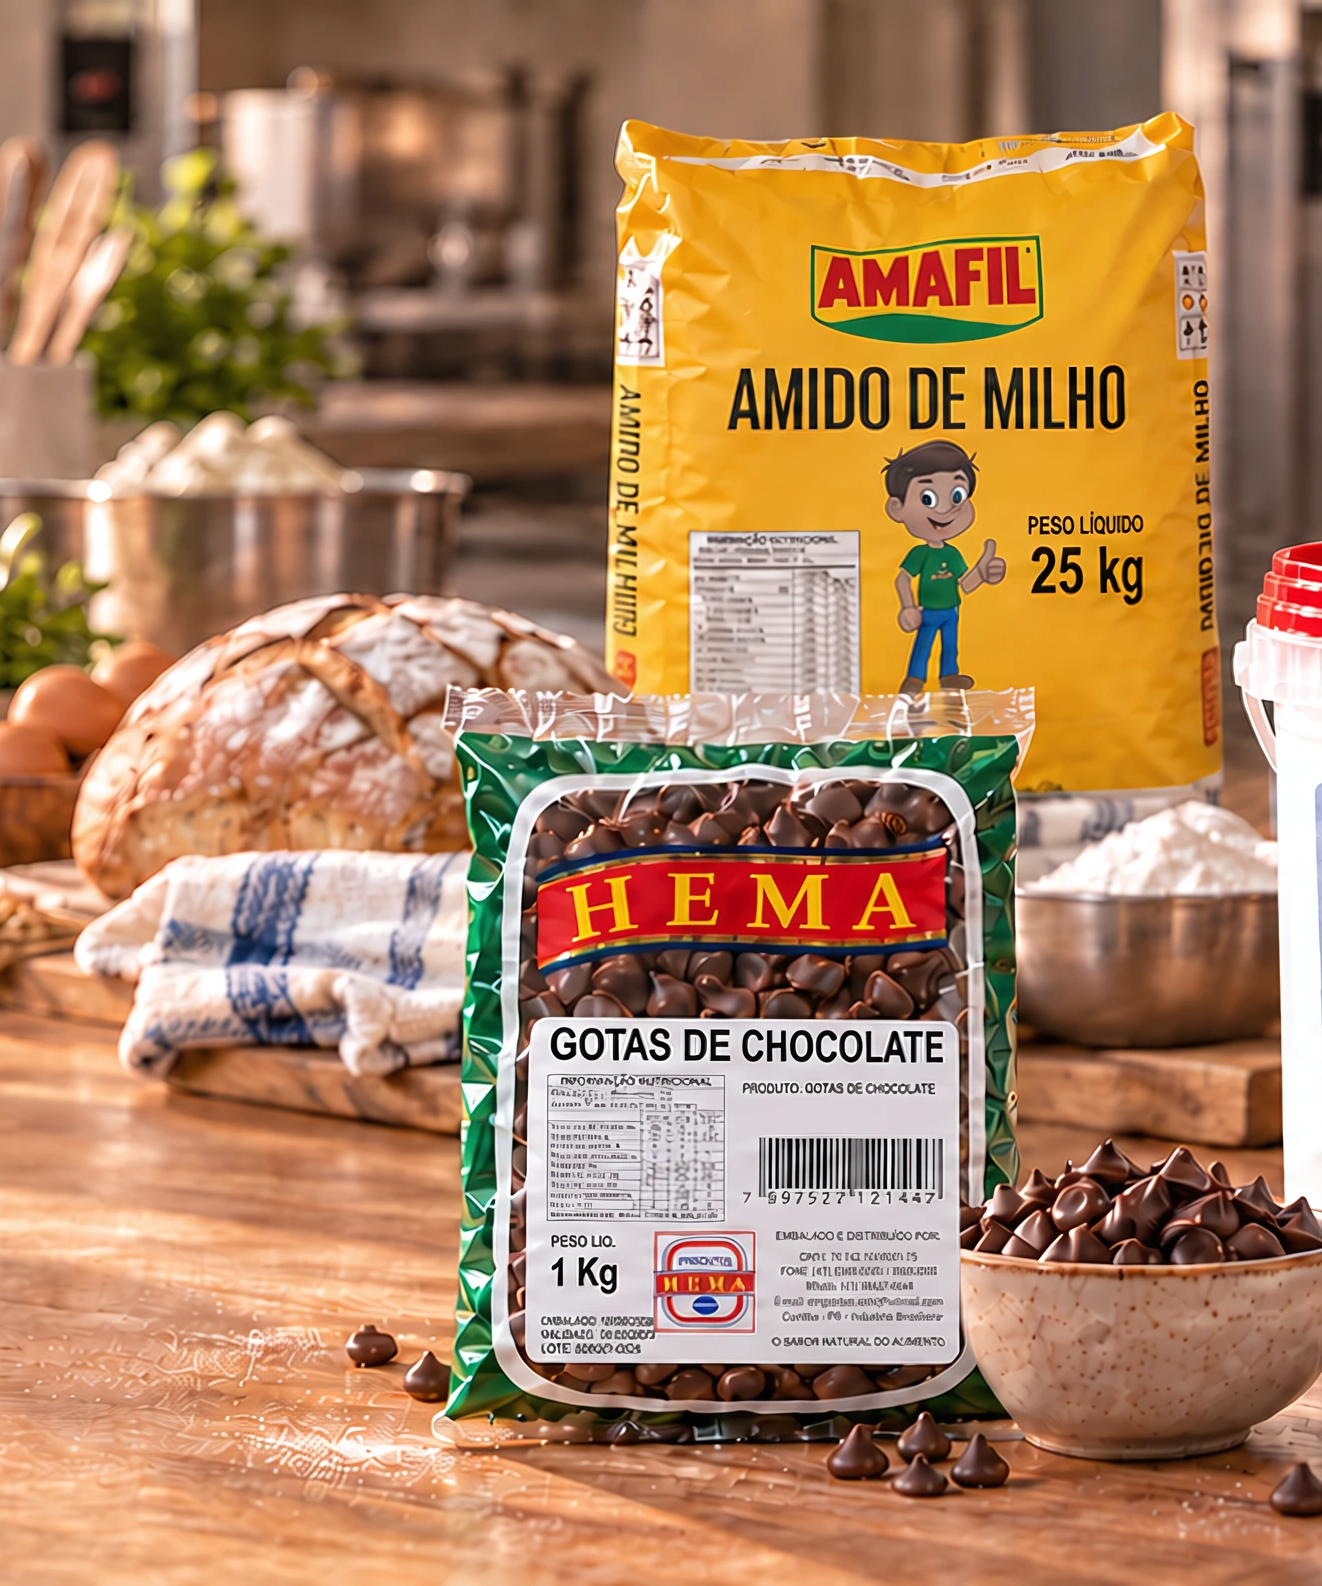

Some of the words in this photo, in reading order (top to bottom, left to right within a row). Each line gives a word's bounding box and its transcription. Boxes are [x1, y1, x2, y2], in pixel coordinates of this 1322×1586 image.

[817, 245, 1038, 309] AMAFIL
[727, 366, 890, 431] AMIDO
[908, 366, 966, 430] DE
[984, 364, 1126, 430] MILHO
[1028, 515, 1075, 536] PESO
[1080, 511, 1144, 535] LÍQUIDO
[1030, 546, 1084, 595] 25
[1099, 545, 1144, 605] kg
[565, 871, 917, 943] HEMA
[550, 1027, 672, 1063] GOTAS
[683, 1029, 731, 1062] DE
[741, 1029, 945, 1063] CHOCOLATE
[742, 1191, 752, 1204] 7
[550, 1234, 588, 1248] PESO
[550, 1256, 565, 1287] 1
[578, 1256, 618, 1294] Kg
